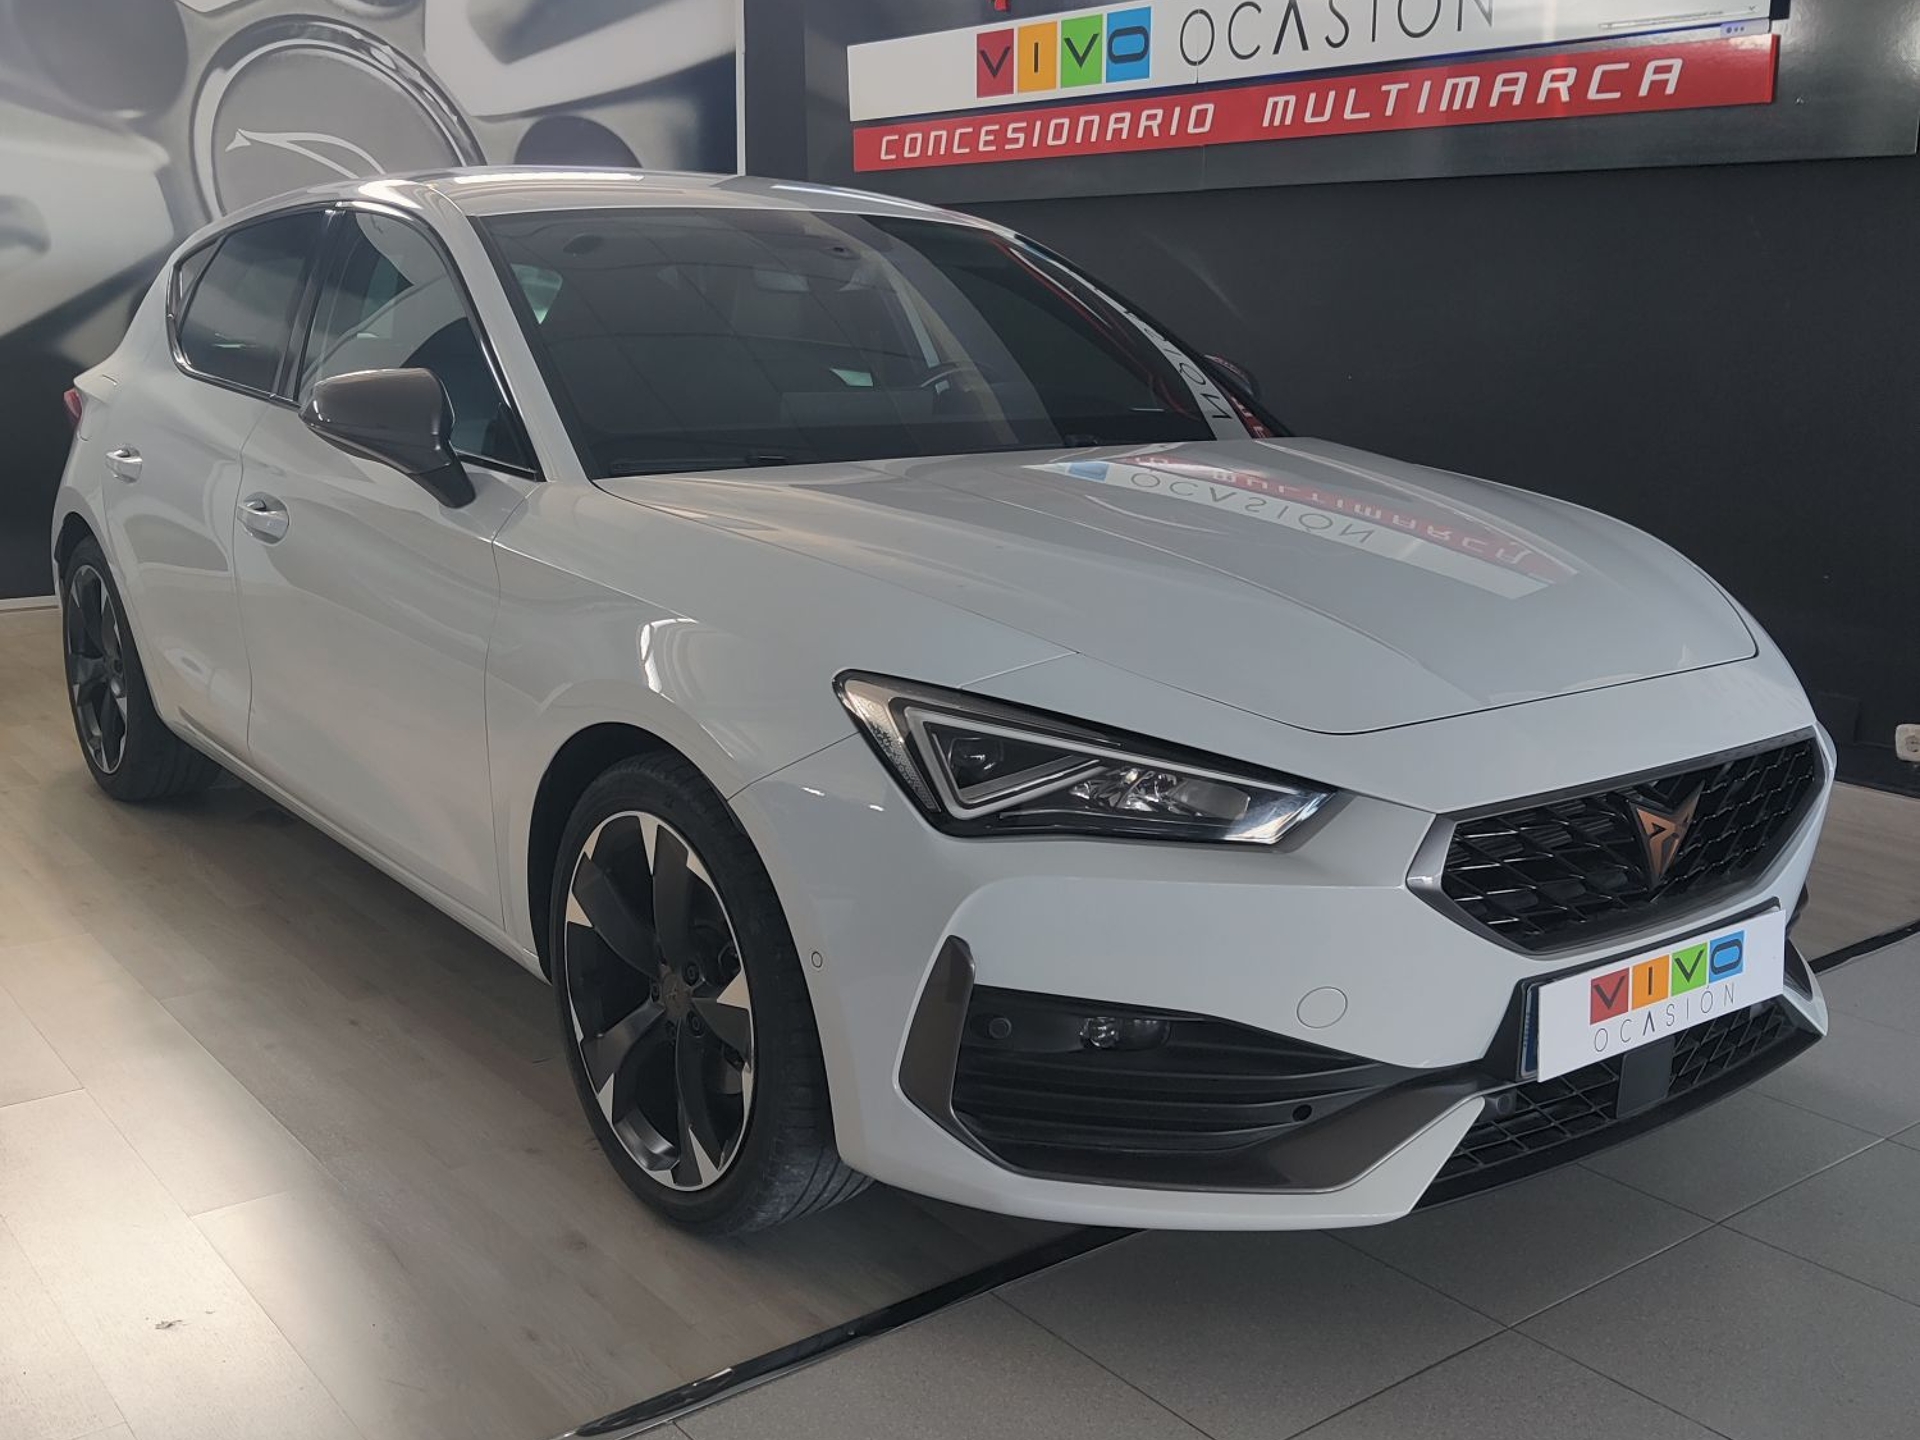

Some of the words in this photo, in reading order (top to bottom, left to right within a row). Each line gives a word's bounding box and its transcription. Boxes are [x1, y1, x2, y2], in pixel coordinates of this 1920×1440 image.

[978, 25, 1149, 79] VIVO
[880, 103, 1216, 161] CONCESIONARIO
[1262, 57, 1684, 127] MULTIMARCA
[1592, 938, 1744, 1010] VIVO
[1593, 982, 1735, 1052] OCASIÓN
